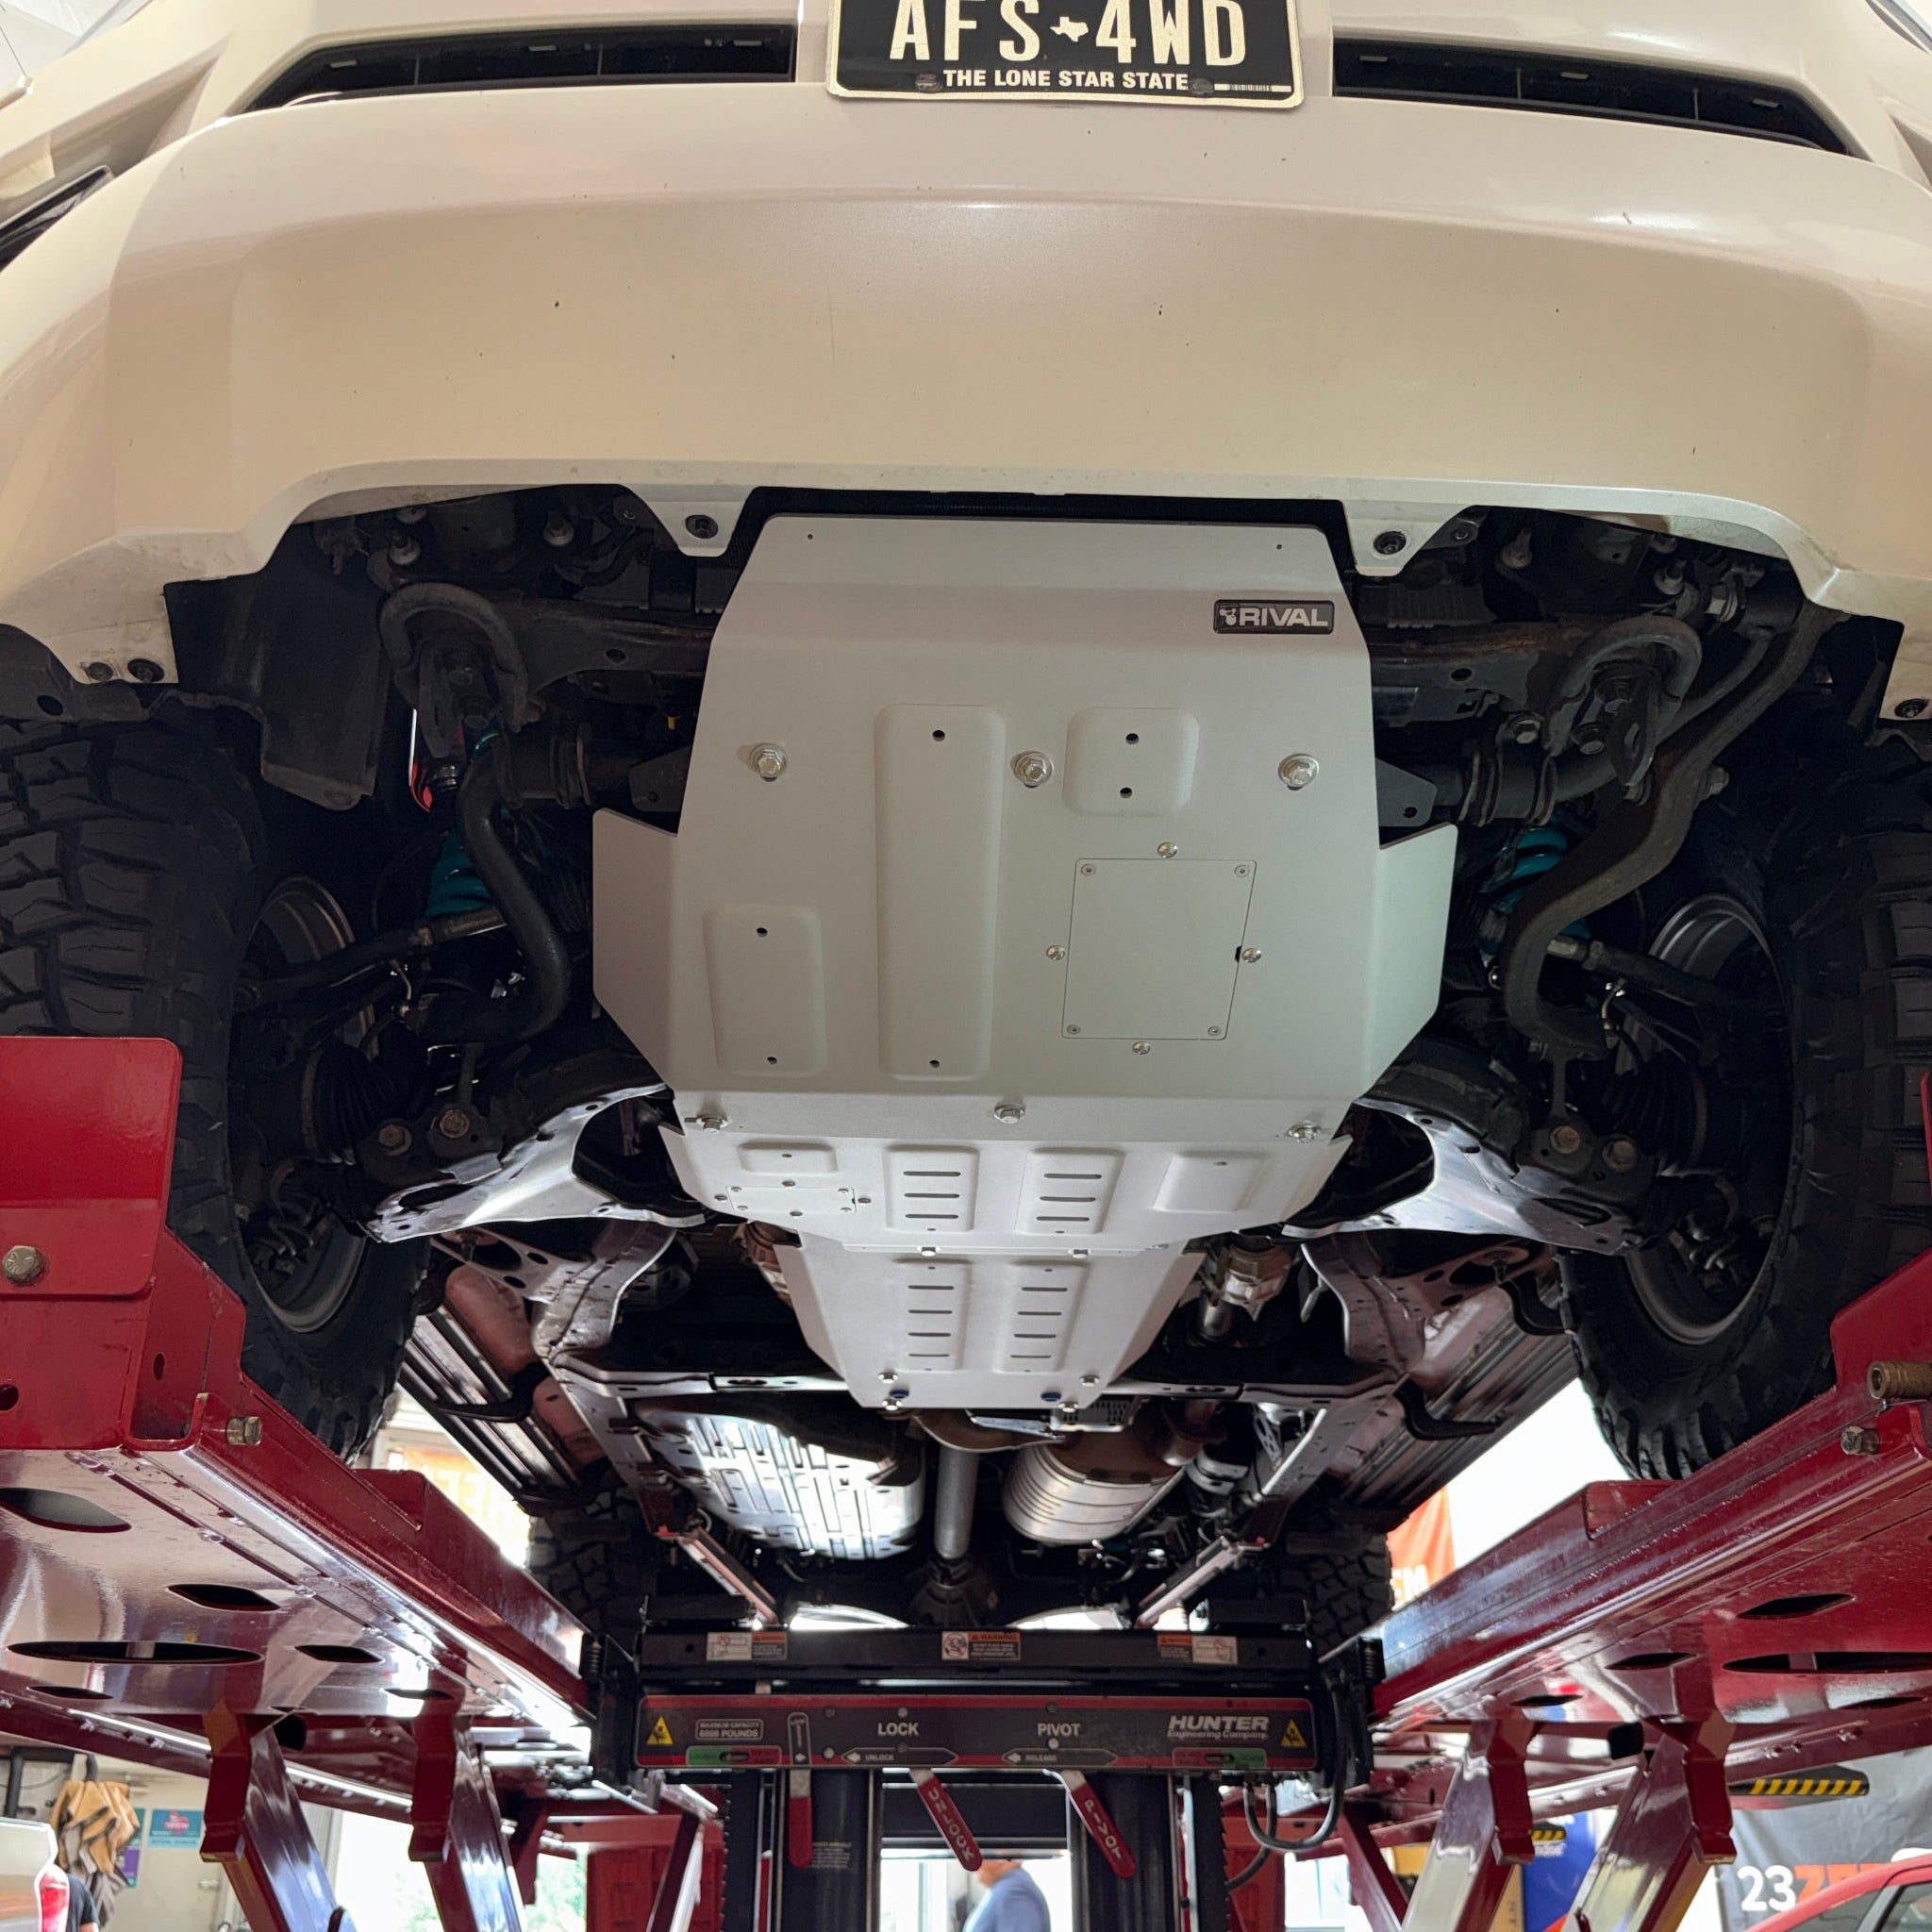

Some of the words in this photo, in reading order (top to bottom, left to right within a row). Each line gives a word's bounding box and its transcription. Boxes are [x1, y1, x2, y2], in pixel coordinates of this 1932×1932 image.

[890, 0, 1040, 61] AFS
[1095, 0, 1246, 66] 4WD
[943, 70, 987, 87] THE
[994, 70, 1051, 87] LONE
[1058, 71, 1115, 89] STAR
[1123, 72, 1189, 91] STATE
[1239, 607, 1329, 627] RIVAL
[877, 1722, 920, 1736] LOCK
[1038, 1723, 1081, 1737] PIVOT
[1169, 1714, 1270, 1730] HUNTER
[721, 1729, 758, 1738] POUNDS
[1167, 1729, 1221, 1740] Engineering
[927, 1787, 974, 1861] UNLOCK
[1085, 1799, 1123, 1859] PIVOT
